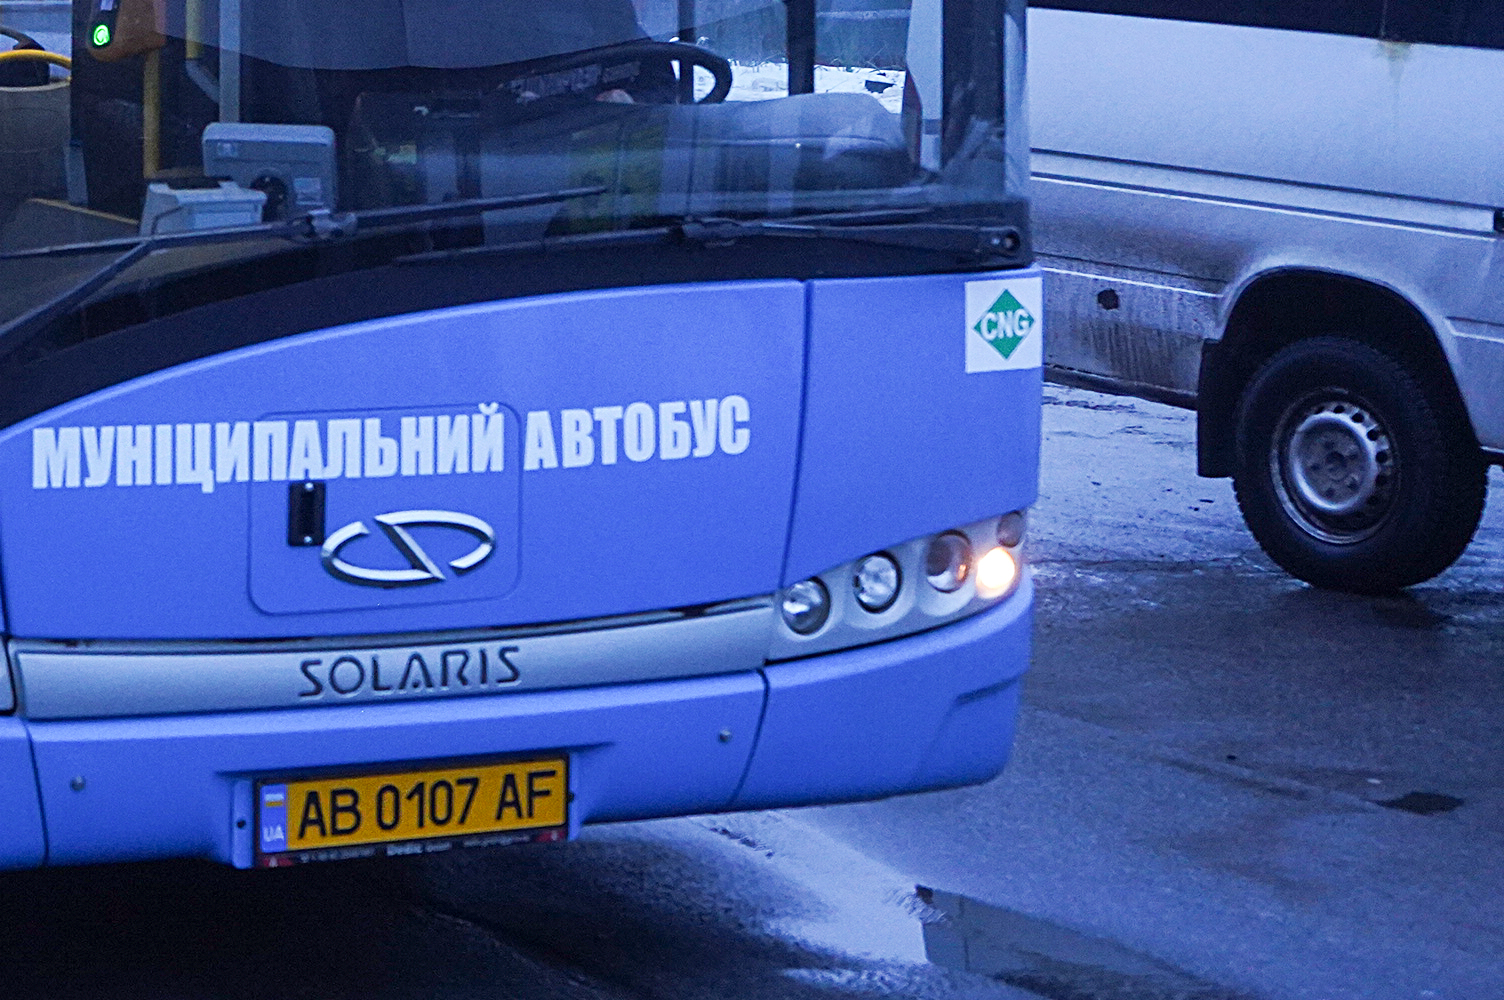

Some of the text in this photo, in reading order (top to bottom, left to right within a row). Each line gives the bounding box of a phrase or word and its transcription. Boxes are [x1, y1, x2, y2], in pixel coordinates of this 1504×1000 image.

[980, 307, 1030, 341] CNG
[31, 395, 752, 492] МУНІЦИПАЛЬНИЙ АВТОБУС
[298, 645, 521, 699] SOLARIS
[262, 824, 286, 844] UA
[297, 787, 363, 841] AB
[375, 776, 481, 832] 0107
